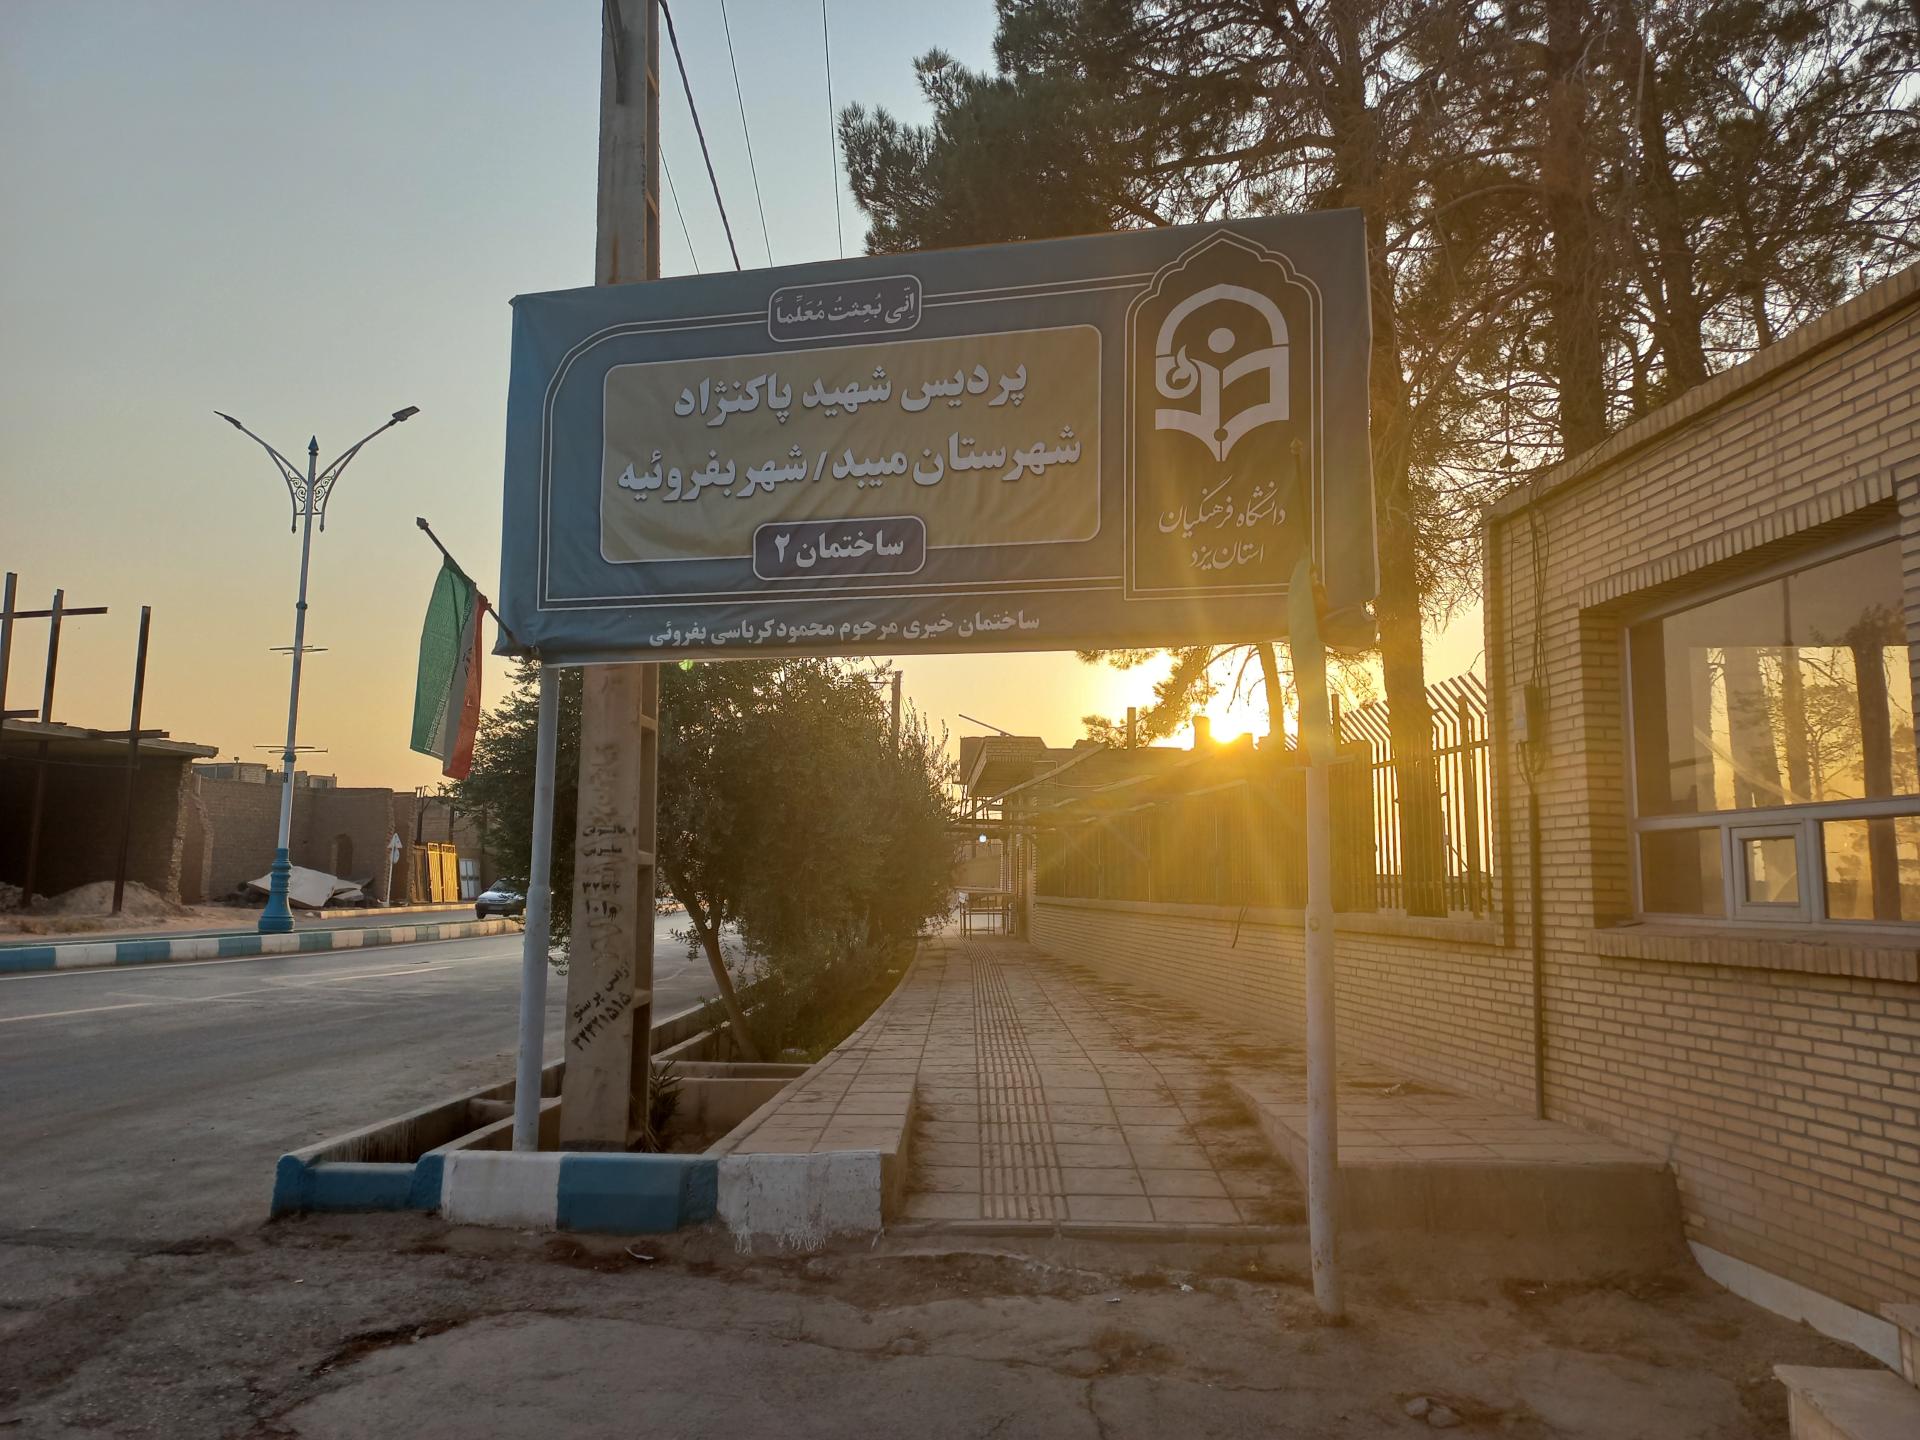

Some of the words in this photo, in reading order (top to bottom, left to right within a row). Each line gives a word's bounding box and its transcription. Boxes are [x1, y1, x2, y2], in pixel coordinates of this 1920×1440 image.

[674, 372, 792, 427] پاکنژاد
[801, 364, 893, 418] شهید
[900, 363, 1027, 413] پردیس
[617, 449, 736, 502] بفروئیه
[736, 444, 808, 498] شهر
[832, 448, 908, 489] میبد
[912, 425, 1081, 486] شهرستان
[1158, 474, 1234, 539] فرهنگیان
[1236, 481, 1286, 528] دانشگاه
[774, 533, 790, 564] ۲
[795, 528, 904, 568] ساختمان
[1190, 546, 1213, 570] یزد
[1212, 540, 1264, 570] استان
[649, 620, 707, 647] بفروئی
[710, 618, 775, 646] کرباسی
[776, 620, 835, 643] محمود
[839, 618, 898, 641] مرحوم
[902, 612, 954, 639] خیری
[958, 609, 1040, 638] ساختمان
